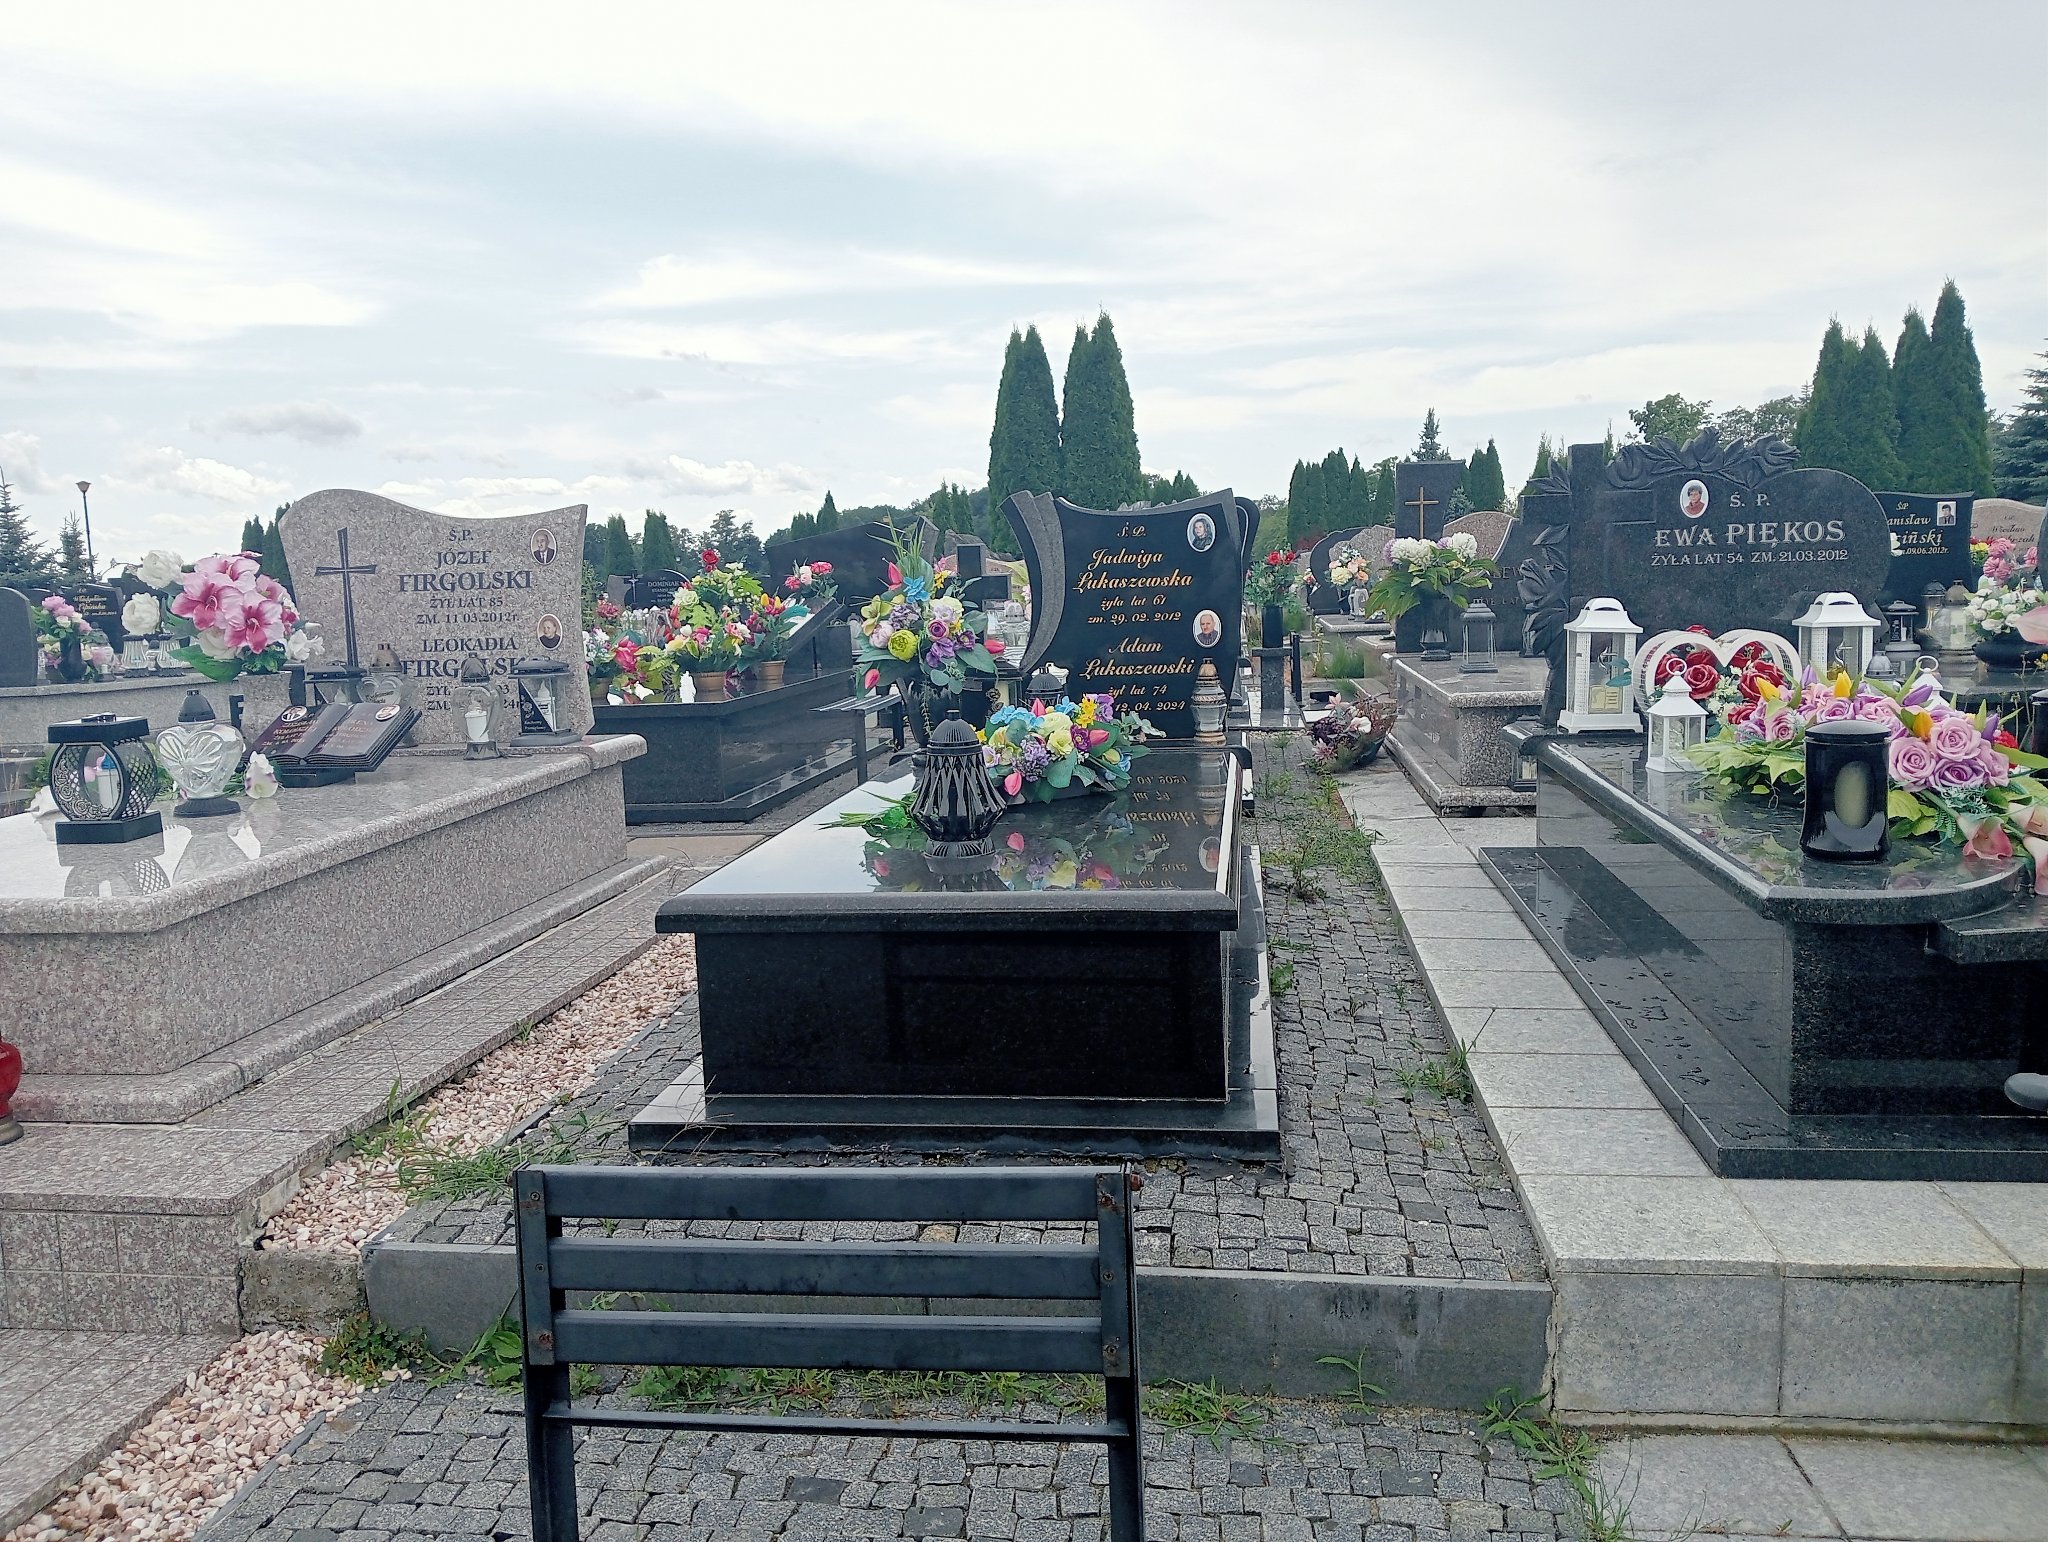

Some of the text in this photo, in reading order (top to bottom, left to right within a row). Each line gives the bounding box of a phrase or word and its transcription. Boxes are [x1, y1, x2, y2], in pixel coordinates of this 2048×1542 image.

[1730, 492, 1770, 507] Ś. P.
[1887, 514, 1931, 525] anisław
[1654, 520, 1846, 549] EWA PIĘKOS
[434, 547, 491, 569] JÓZEF
[1087, 548, 1164, 570] Jadwiga
[1651, 553, 1691, 566] ŻYŁA
[1695, 553, 1723, 565] LAT
[1727, 552, 1744, 563] 54
[1779, 550, 1848, 562] 21.03.2012
[397, 571, 532, 592] FIRGOLSKI
[1073, 569, 1193, 593] Łukaszewska
[458, 597, 486, 608] LAT
[489, 597, 503, 607] 85
[1101, 597, 1124, 611] żyła
[1131, 596, 1146, 606] lat
[416, 613, 440, 624] ZM.
[1088, 611, 1181, 626] zm. 29. 02. 2012
[422, 638, 518, 652] LEOKADIA
[1109, 637, 1163, 654] Adam
[401, 657, 525, 678] FIRGLSK
[1080, 657, 1195, 680] Łukaszewski
[1130, 685, 1146, 695] lat
[1153, 685, 1168, 694] 74
[1115, 701, 1185, 712] 12. 04. 2024
